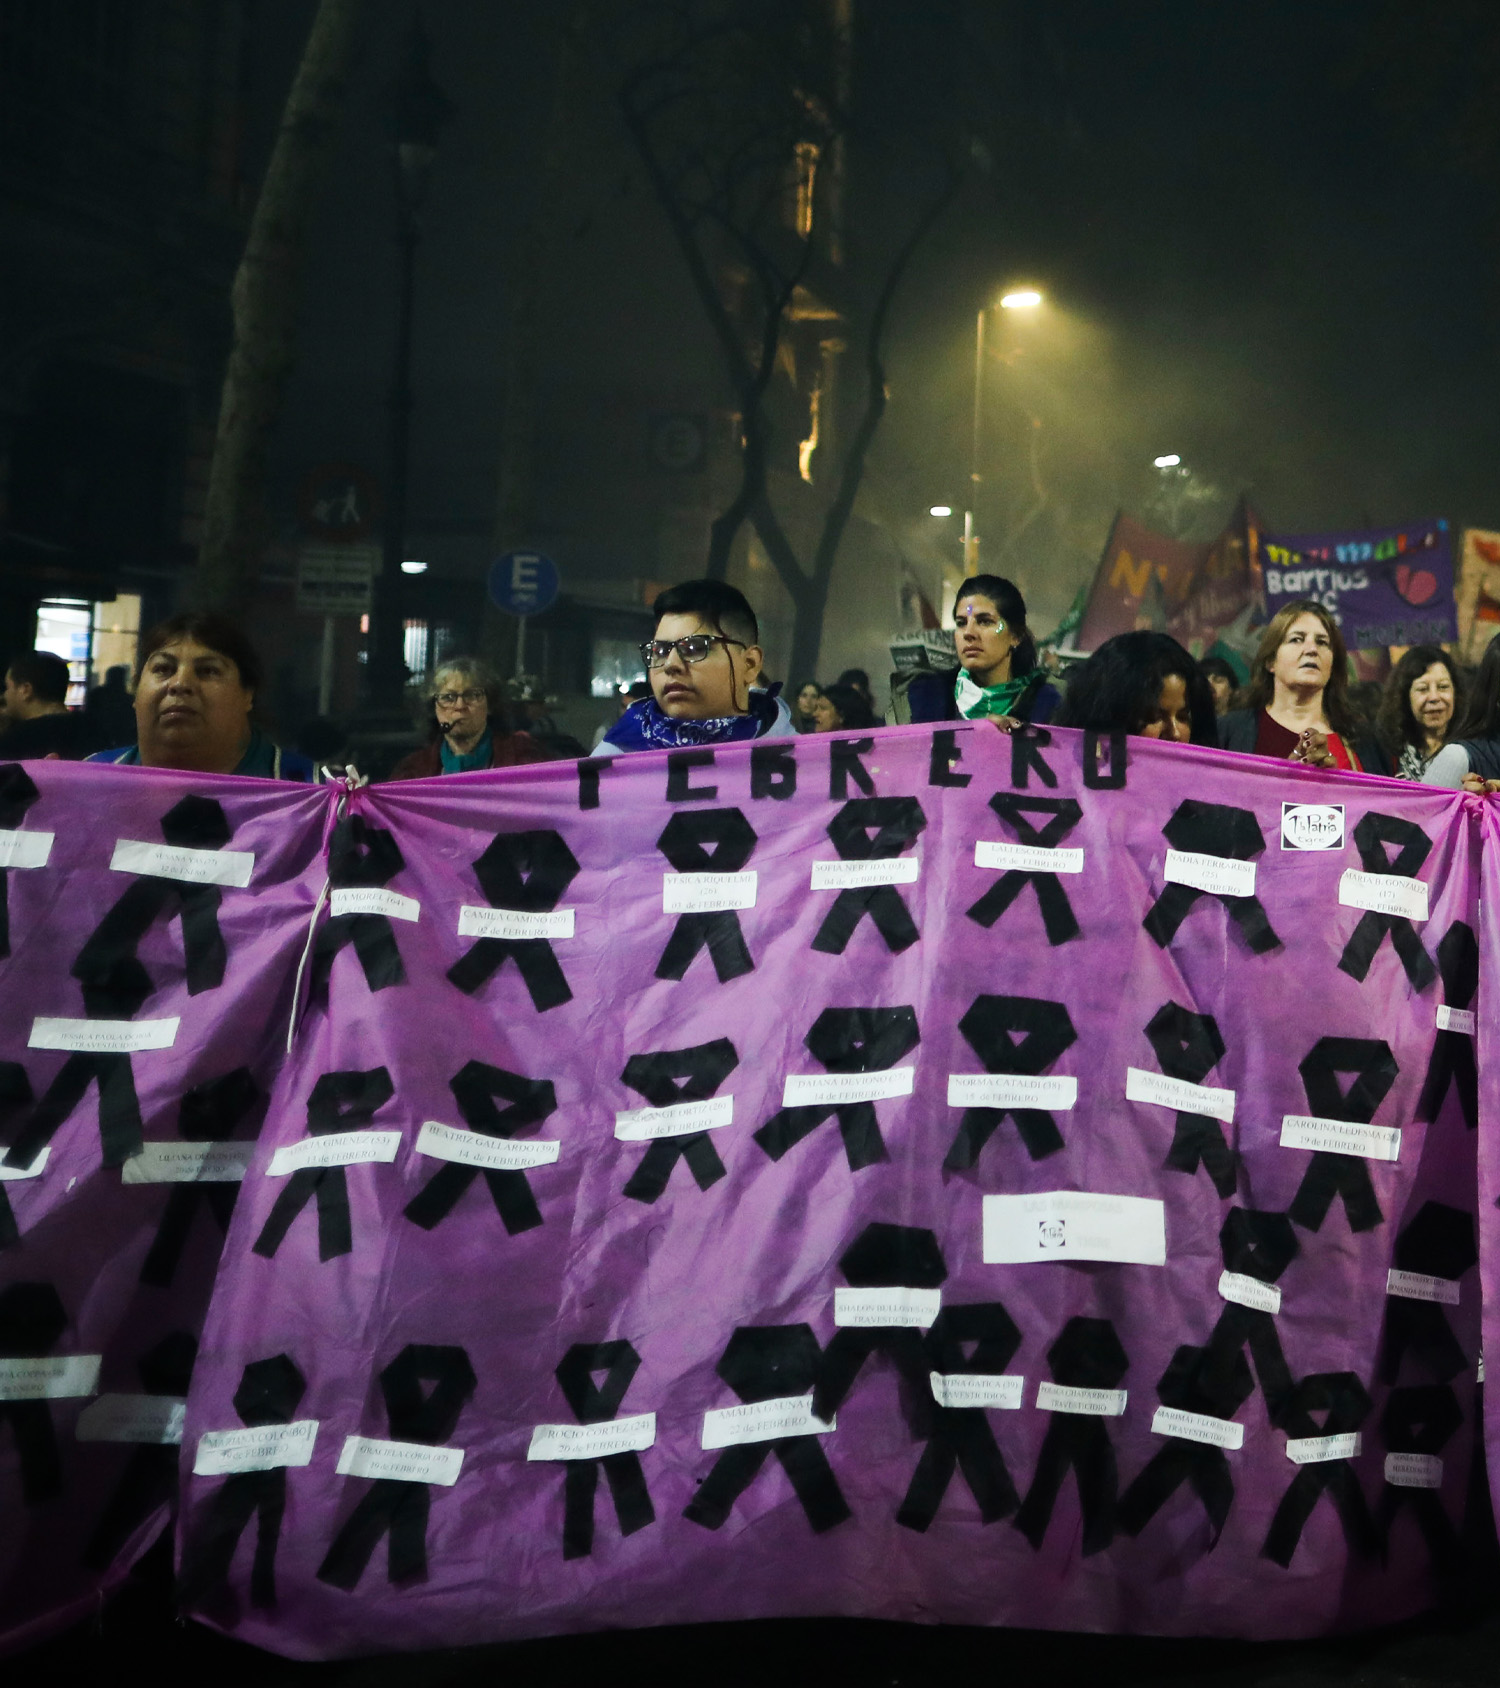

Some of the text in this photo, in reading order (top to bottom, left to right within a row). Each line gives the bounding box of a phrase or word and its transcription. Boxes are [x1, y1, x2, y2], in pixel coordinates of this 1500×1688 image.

[512, 555, 539, 590] E
[1012, 846, 1059, 857] ESCOBAR
[815, 864, 844, 872] SOFIA
[1023, 858, 1066, 869] FEBRERO
[849, 875, 894, 885] FEBRERO
[698, 900, 742, 909] FEBRERO
[463, 911, 505, 922] CAMILA
[506, 913, 547, 922] CAMINO
[502, 928, 548, 936] FEBRERO
[955, 1079, 993, 1087] NORMA
[837, 1090, 885, 1100] FEBRERO
[992, 1094, 1038, 1102] FEBRERO
[678, 1106, 708, 1119] ORTIZ
[667, 1119, 712, 1133] FEBRERO
[1287, 1118, 1340, 1133] CAROLINA
[429, 1125, 555, 1154] BEATRIZ GALLARDO (39)
[1323, 1138, 1366, 1152] FEBRERO
[330, 1150, 377, 1161] FEBRERO
[487, 1154, 536, 1166] FEBRERO
[759, 1416, 807, 1431] FEBRERO
[547, 1428, 585, 1439] ROCIO
[586, 1425, 629, 1438] CORTEZ
[586, 1439, 636, 1452] FEBRERO
[390, 1464, 430, 1474] FEBRERO
